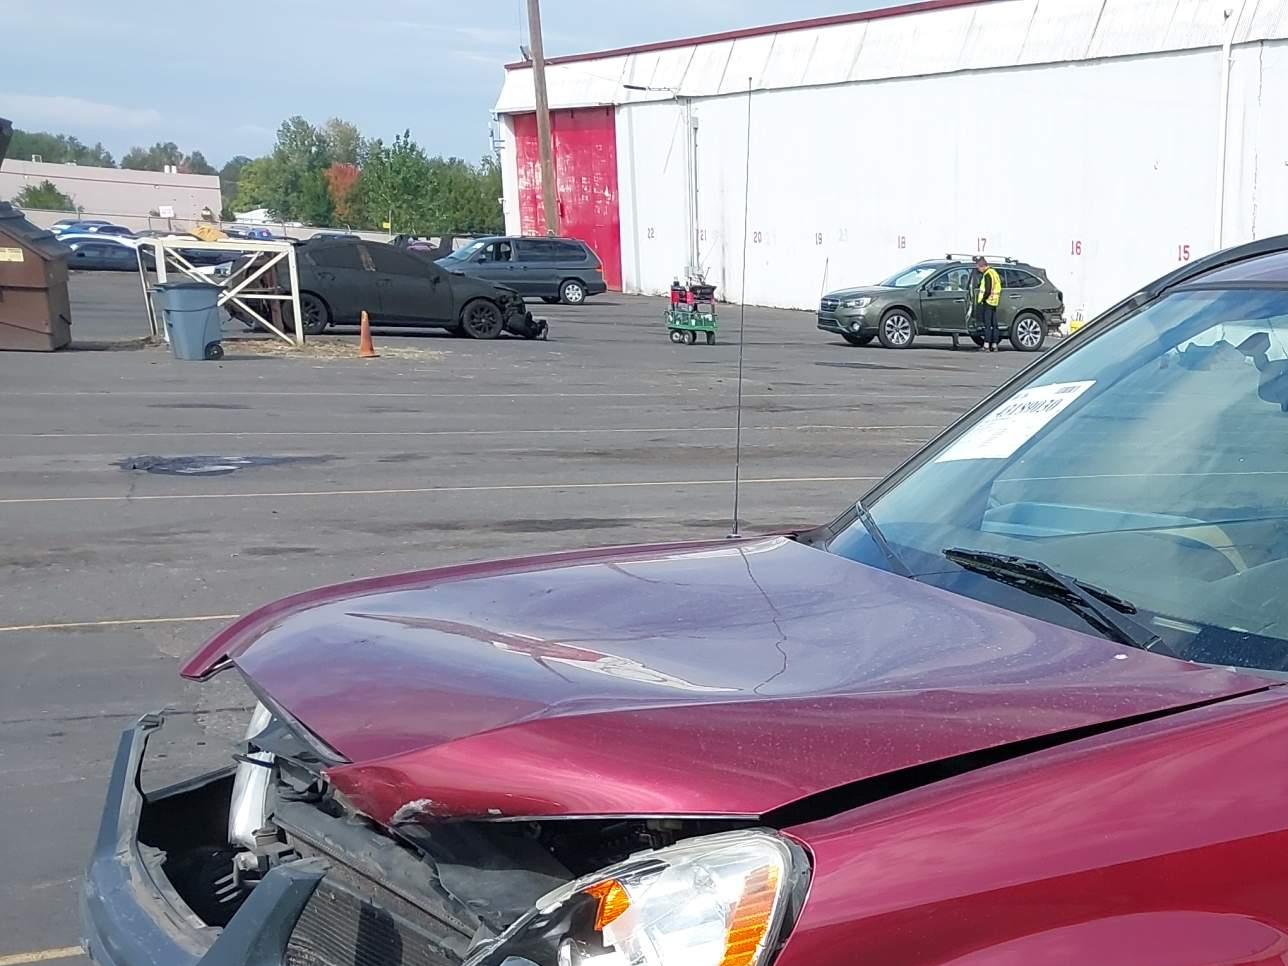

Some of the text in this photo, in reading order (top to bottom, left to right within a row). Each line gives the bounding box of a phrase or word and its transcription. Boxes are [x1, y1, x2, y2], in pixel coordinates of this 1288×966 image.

[753, 230, 762, 244] 20
[897, 235, 906, 249] 18
[977, 236, 987, 252] 17
[1071, 239, 1082, 256] 16
[1178, 245, 1190, 261] 15
